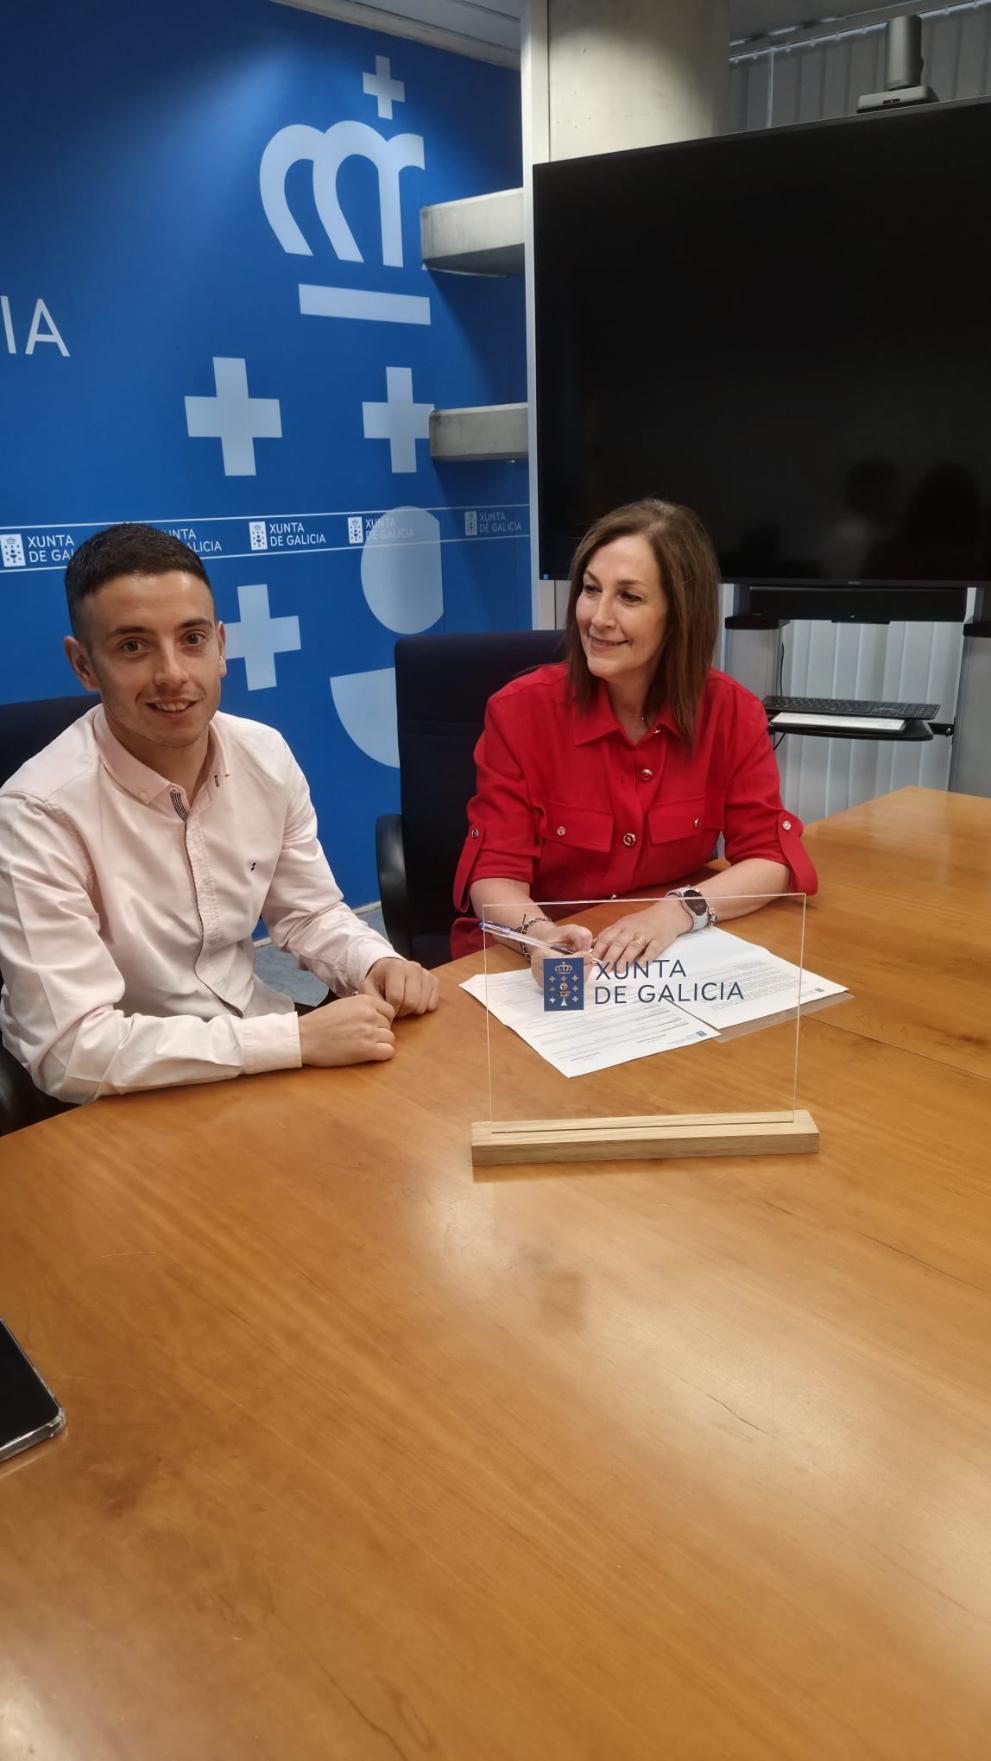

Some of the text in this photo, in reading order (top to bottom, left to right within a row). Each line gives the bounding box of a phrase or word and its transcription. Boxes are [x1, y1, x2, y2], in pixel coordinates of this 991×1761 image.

[270, 522, 305, 534] XUNTA
[27, 535, 75, 548] XUNTA
[270, 533, 327, 547] DE GALICIA
[29, 550, 48, 563] DE
[595, 959, 687, 980] XUNTA
[594, 981, 745, 1005] DE GALICIA
